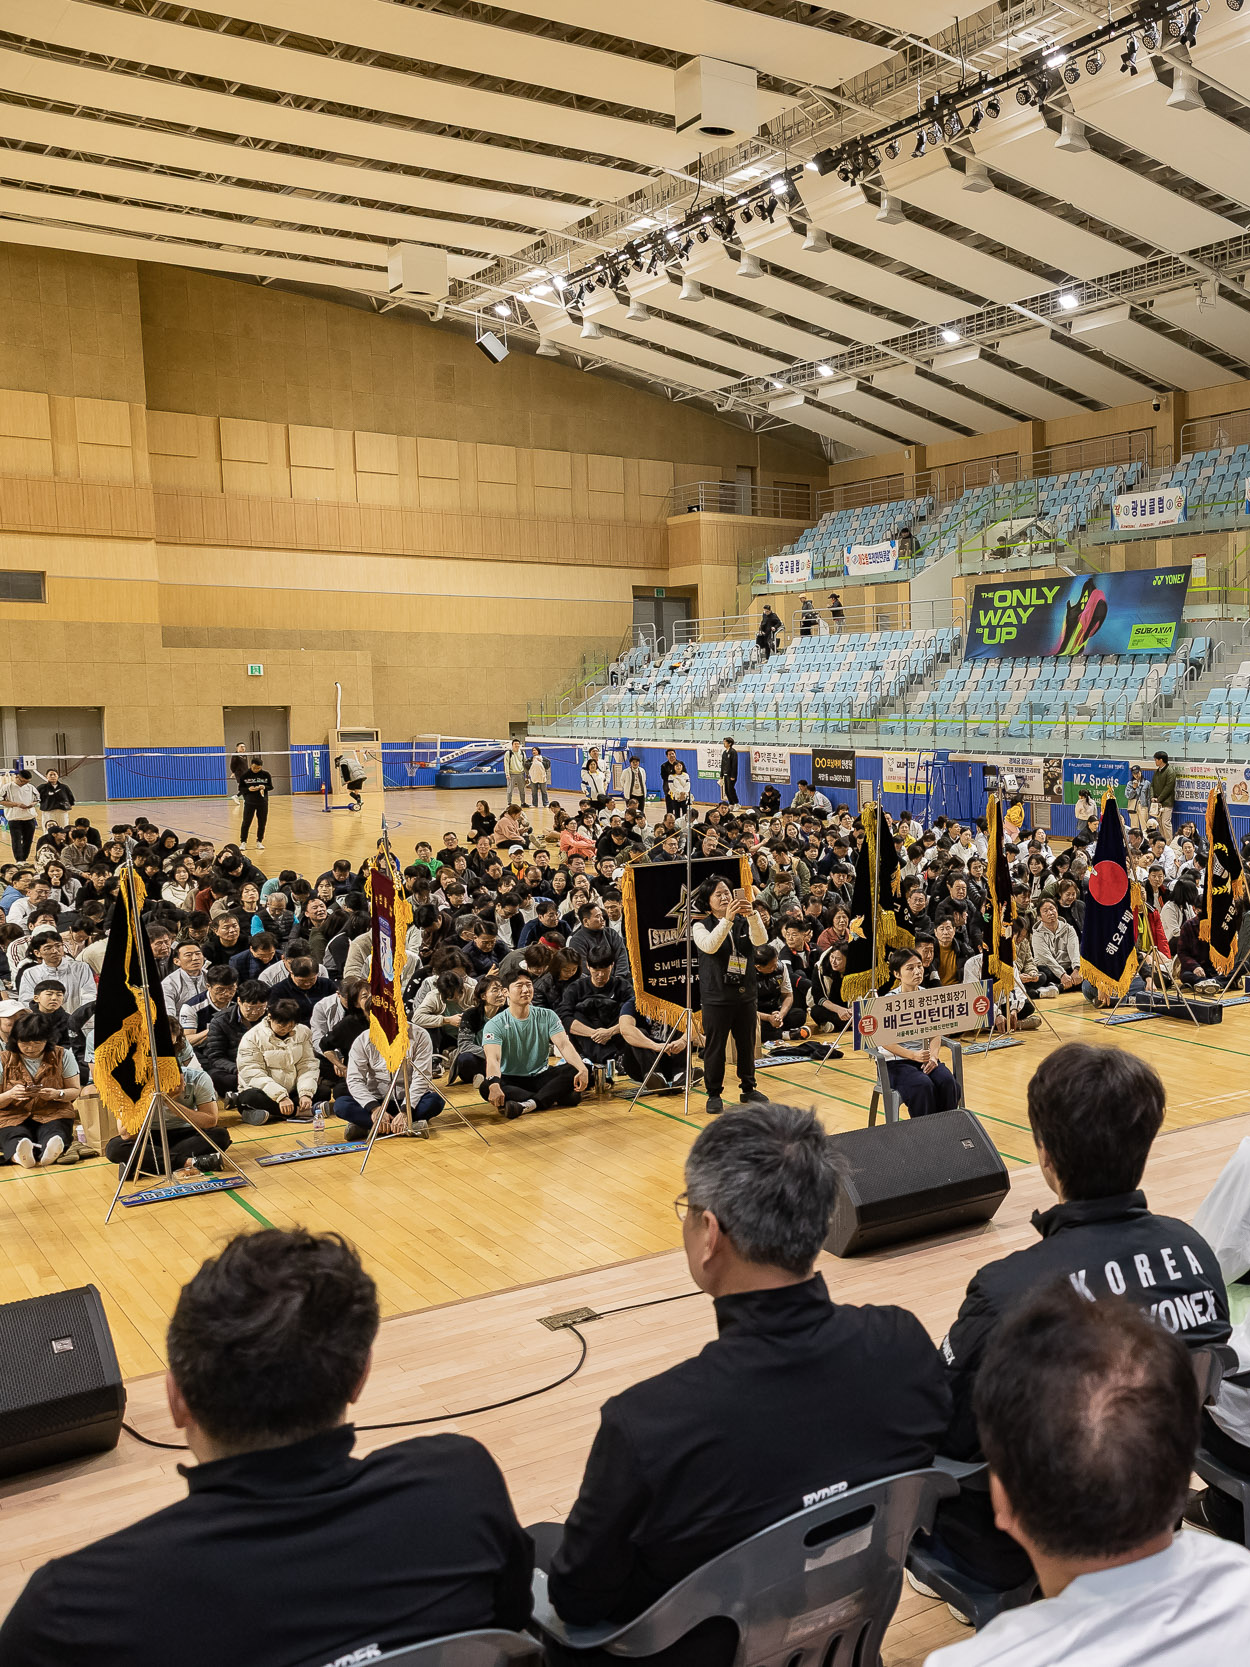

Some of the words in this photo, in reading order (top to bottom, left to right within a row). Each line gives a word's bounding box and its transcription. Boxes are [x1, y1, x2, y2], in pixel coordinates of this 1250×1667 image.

[1131, 496, 1165, 517] 광남클럽
[1165, 572, 1185, 586] YONEX
[993, 585, 1061, 608] ONLY
[979, 606, 1035, 626] WAY
[982, 626, 1018, 645] UP
[1073, 773, 1087, 786] MZ
[1089, 774, 1119, 789] Sports
[885, 998, 915, 1013] 제31회
[918, 990, 967, 1007] 광진구협회장기
[976, 999, 988, 1013] 승
[861, 1018, 875, 1033] 필
[883, 1002, 969, 1030] 배드민턴대회
[1069, 1245, 1204, 1303] KOREA
